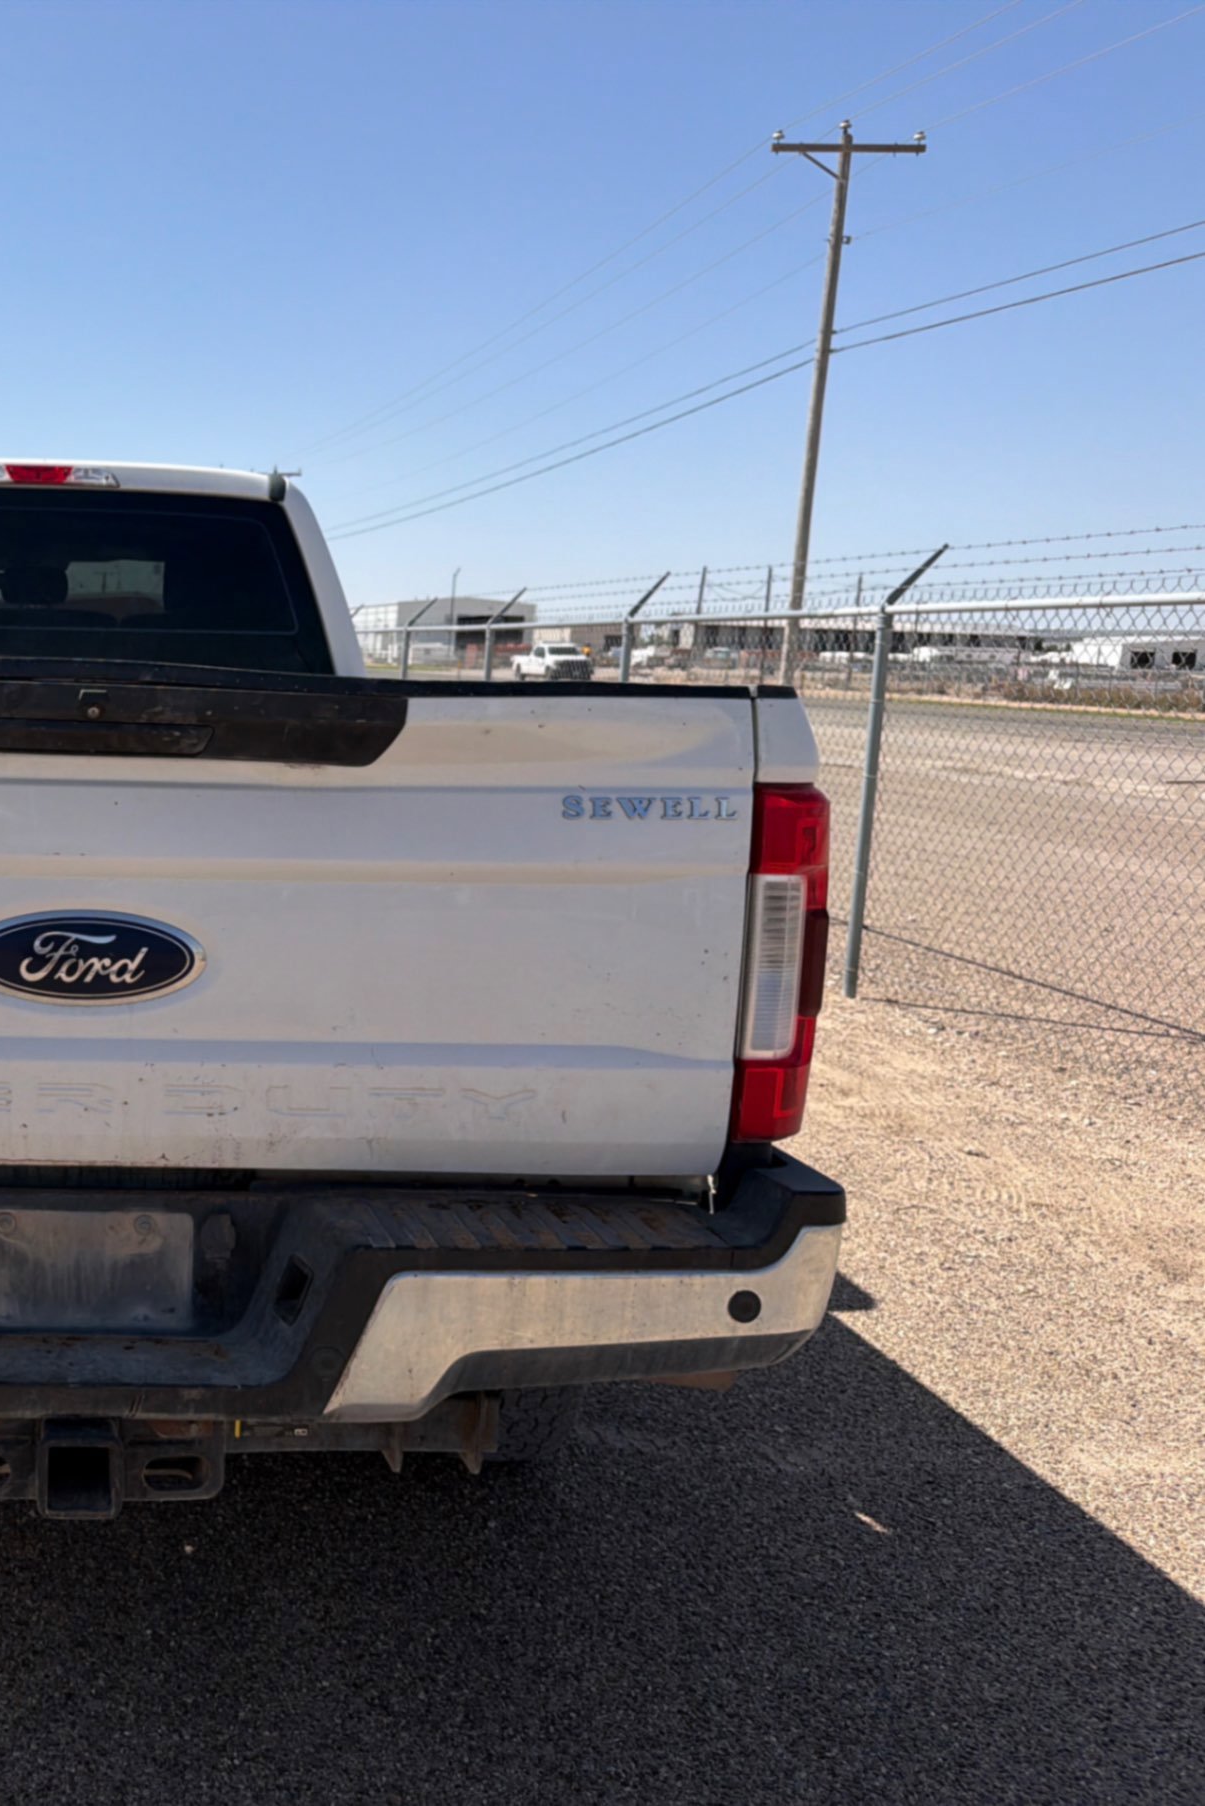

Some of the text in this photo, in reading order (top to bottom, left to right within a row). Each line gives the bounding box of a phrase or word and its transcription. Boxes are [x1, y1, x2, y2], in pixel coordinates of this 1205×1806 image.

[562, 795, 737, 820] SEWELL
[19, 931, 148, 983] Ford
[163, 1083, 537, 1119] DUTY
